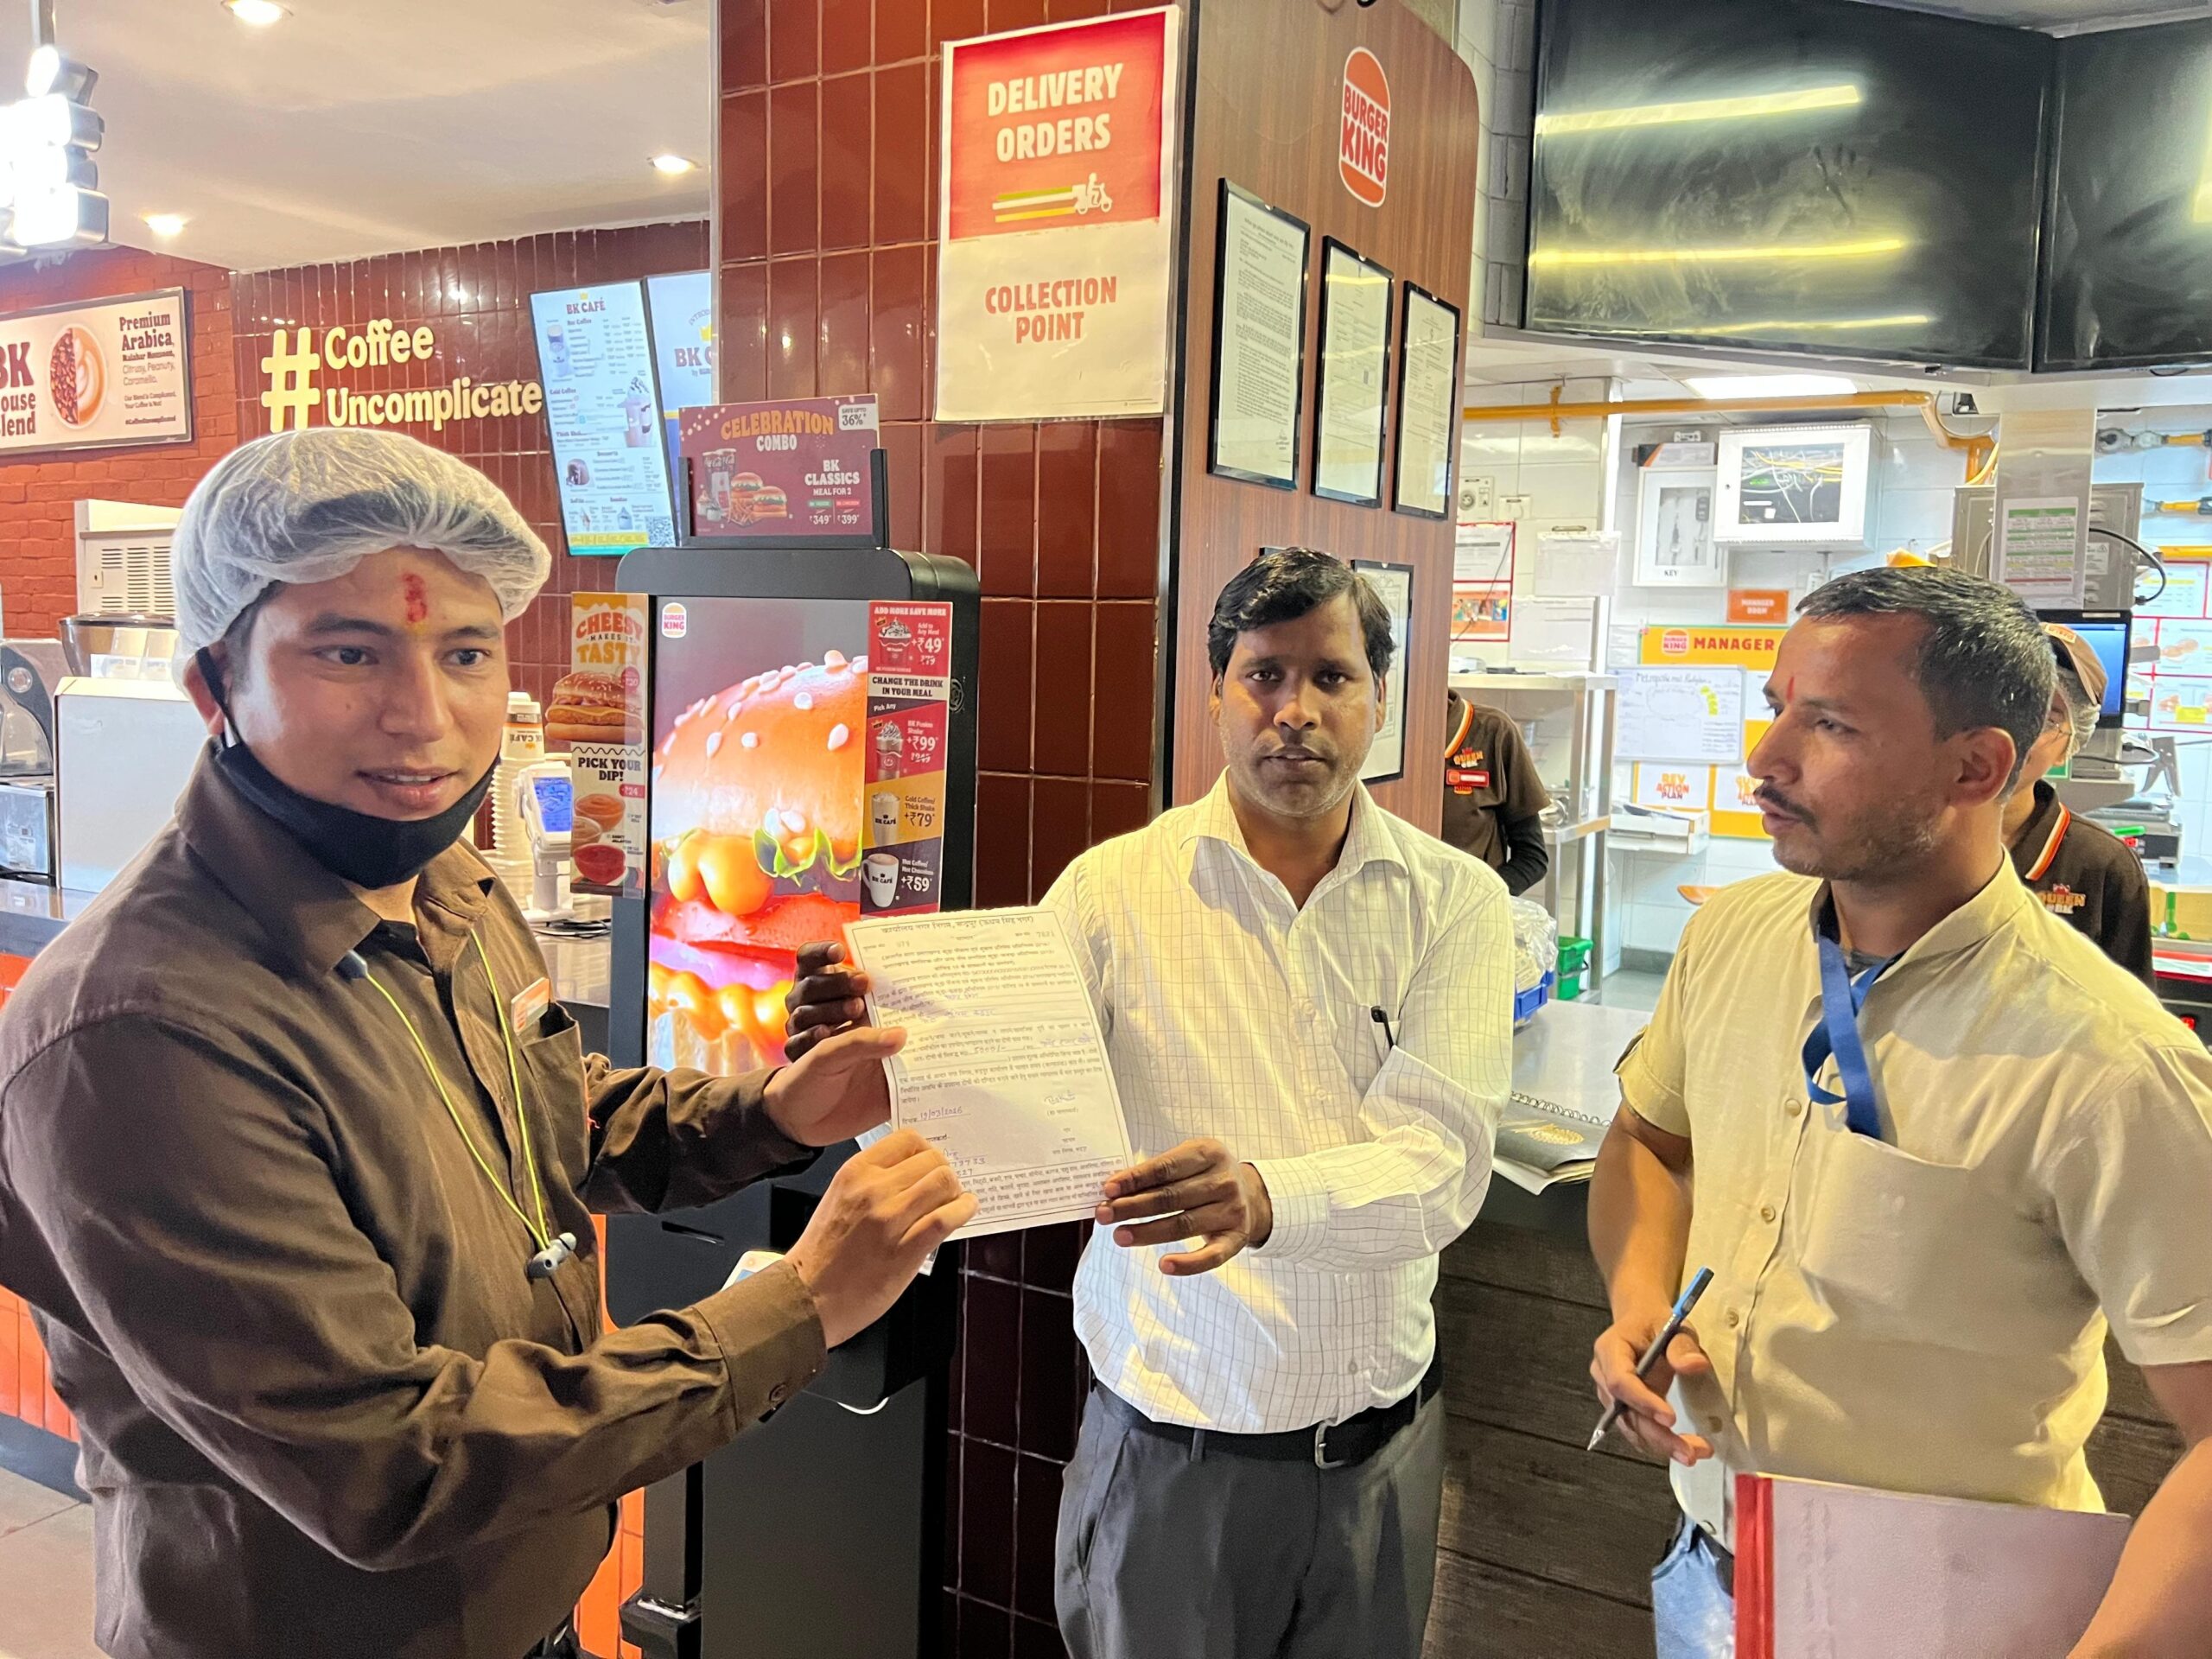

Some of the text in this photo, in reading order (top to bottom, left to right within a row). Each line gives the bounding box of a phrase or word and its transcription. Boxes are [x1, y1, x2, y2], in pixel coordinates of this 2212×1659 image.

[988, 63, 1123, 118] DELIVERY
[1344, 84, 1389, 143] BURGER
[996, 113, 1111, 162] ORDERS
[1341, 116, 1387, 182] KING
[566, 297, 606, 315] BK CAFÉ
[985, 276, 1118, 315] COLLECTION
[119, 311, 171, 331] Premium
[1016, 311, 1084, 344] POINT
[122, 329, 175, 351] Arabica,
[325, 318, 435, 369] Coffee
[674, 347, 702, 367] BK
[0, 393, 36, 412] ouse
[0, 410, 36, 436] lend
[721, 410, 835, 440] CELEBRATION
[756, 434, 798, 452] COMBO
[823, 459, 840, 472] BK
[804, 472, 860, 486] CLASSICS
[576, 612, 643, 640] CHEESY
[664, 621, 684, 630] KING
[576, 641, 640, 664] TASTY
[1694, 637, 1775, 651] MANAGER
[873, 677, 903, 685] CHANGE
[920, 679, 944, 688] DRINK
[578, 757, 641, 772] PICK YOUR
[599, 771, 624, 781] DIP!
